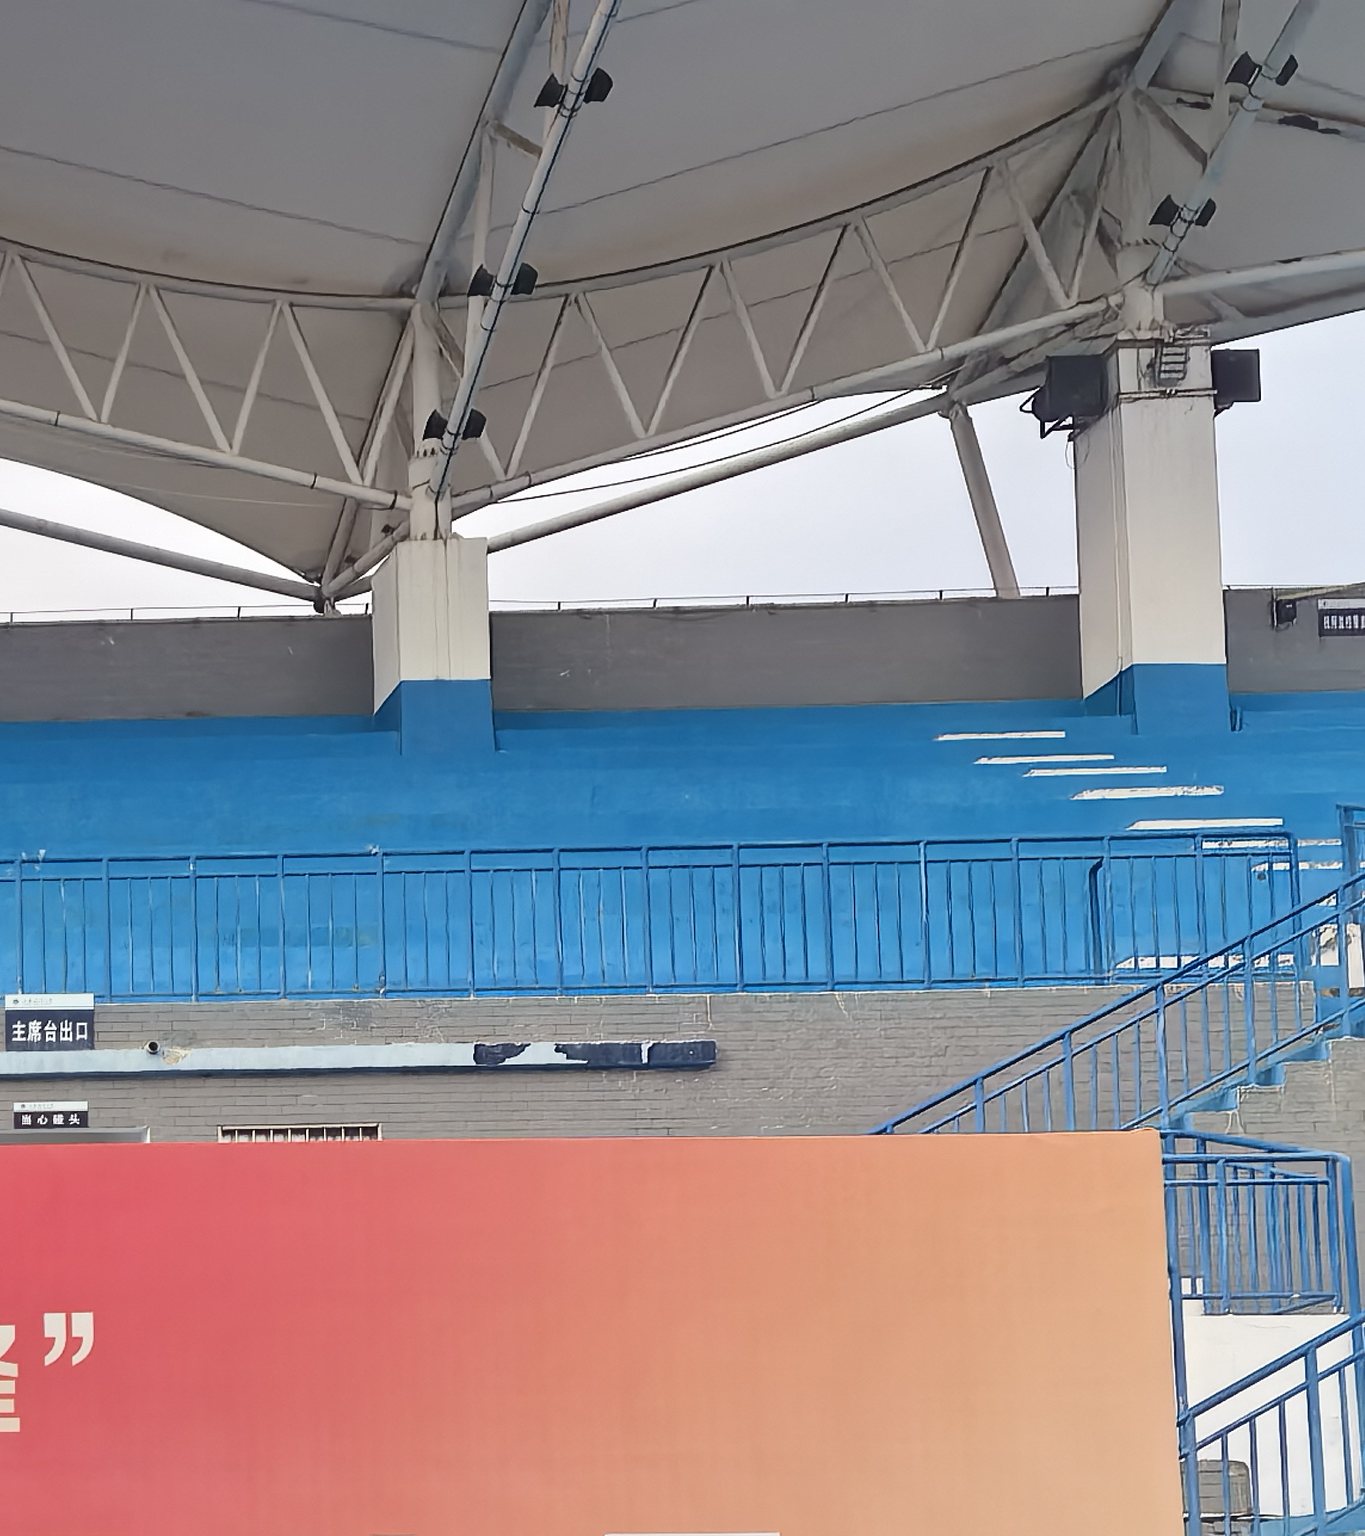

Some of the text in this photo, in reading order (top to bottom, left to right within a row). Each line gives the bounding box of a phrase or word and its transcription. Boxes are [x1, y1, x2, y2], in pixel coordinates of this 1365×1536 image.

[12, 1020, 88, 1043] 主席台出口
